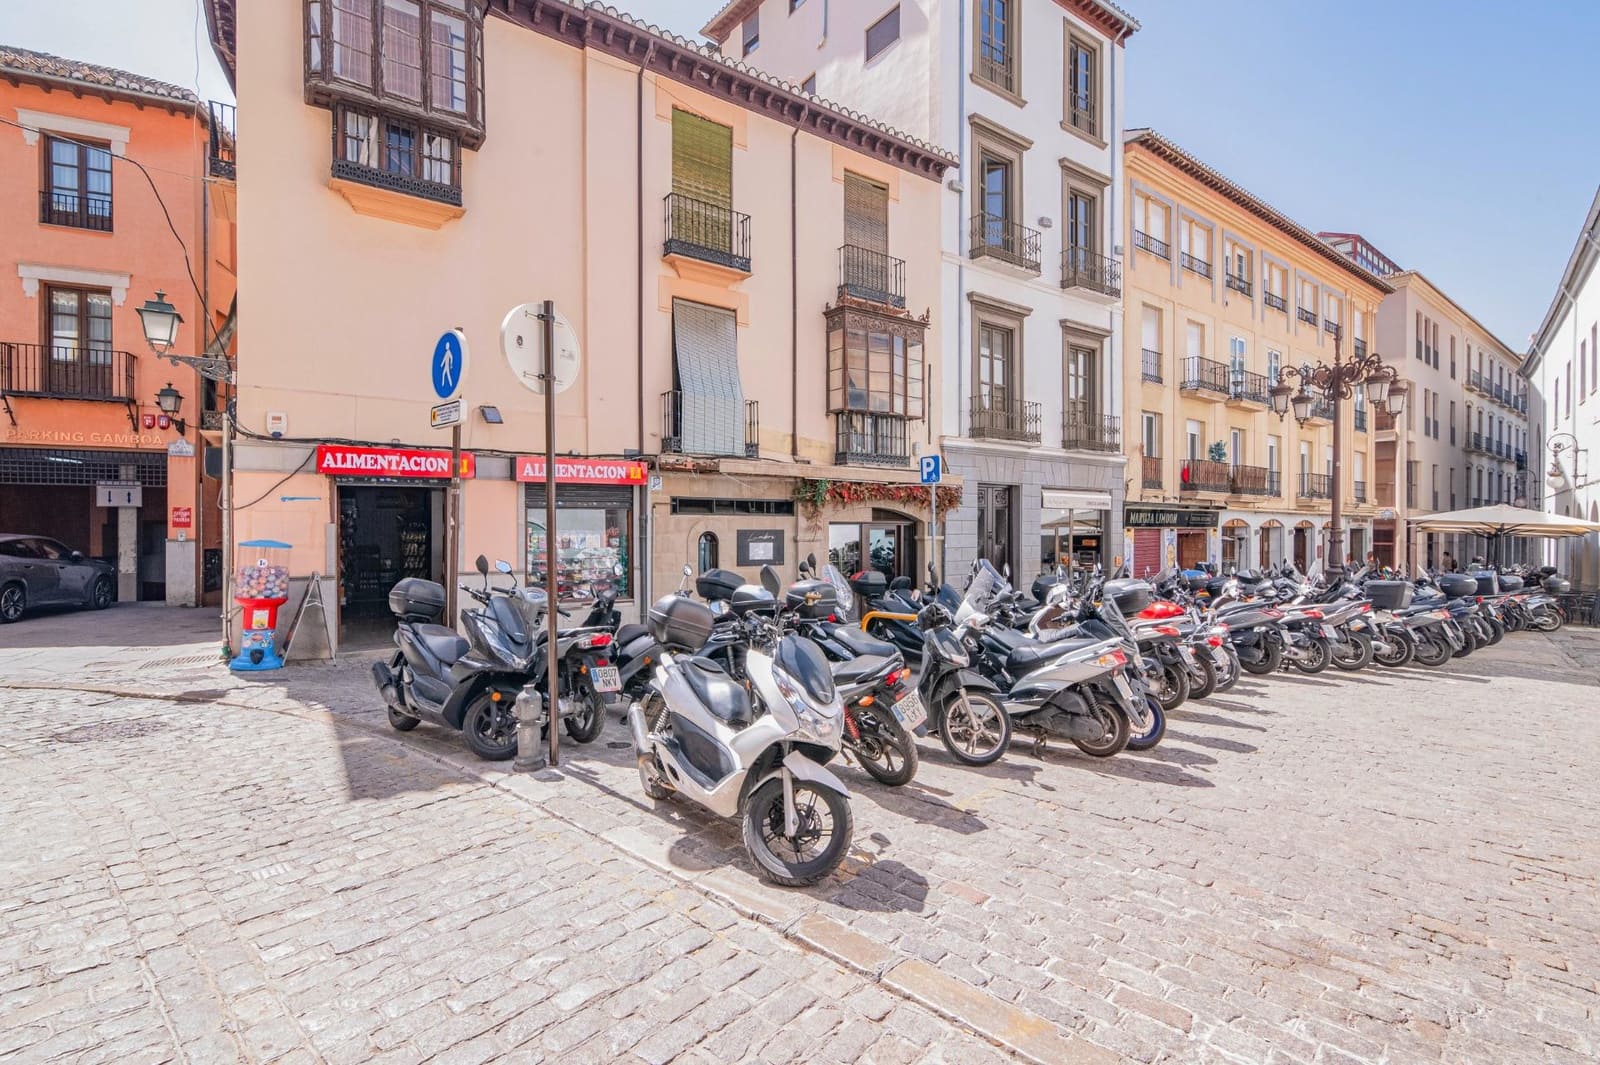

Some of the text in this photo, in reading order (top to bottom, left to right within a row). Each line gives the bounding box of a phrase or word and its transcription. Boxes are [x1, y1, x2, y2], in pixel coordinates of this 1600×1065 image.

[6, 429, 162, 445] PARKING GAMBOA
[322, 452, 448, 472] ALIMENTACION
[922, 457, 935, 480] P
[1130, 511, 1154, 524] MARUJA
[598, 668, 617, 678] 0807
[602, 677, 616, 688] NKV
